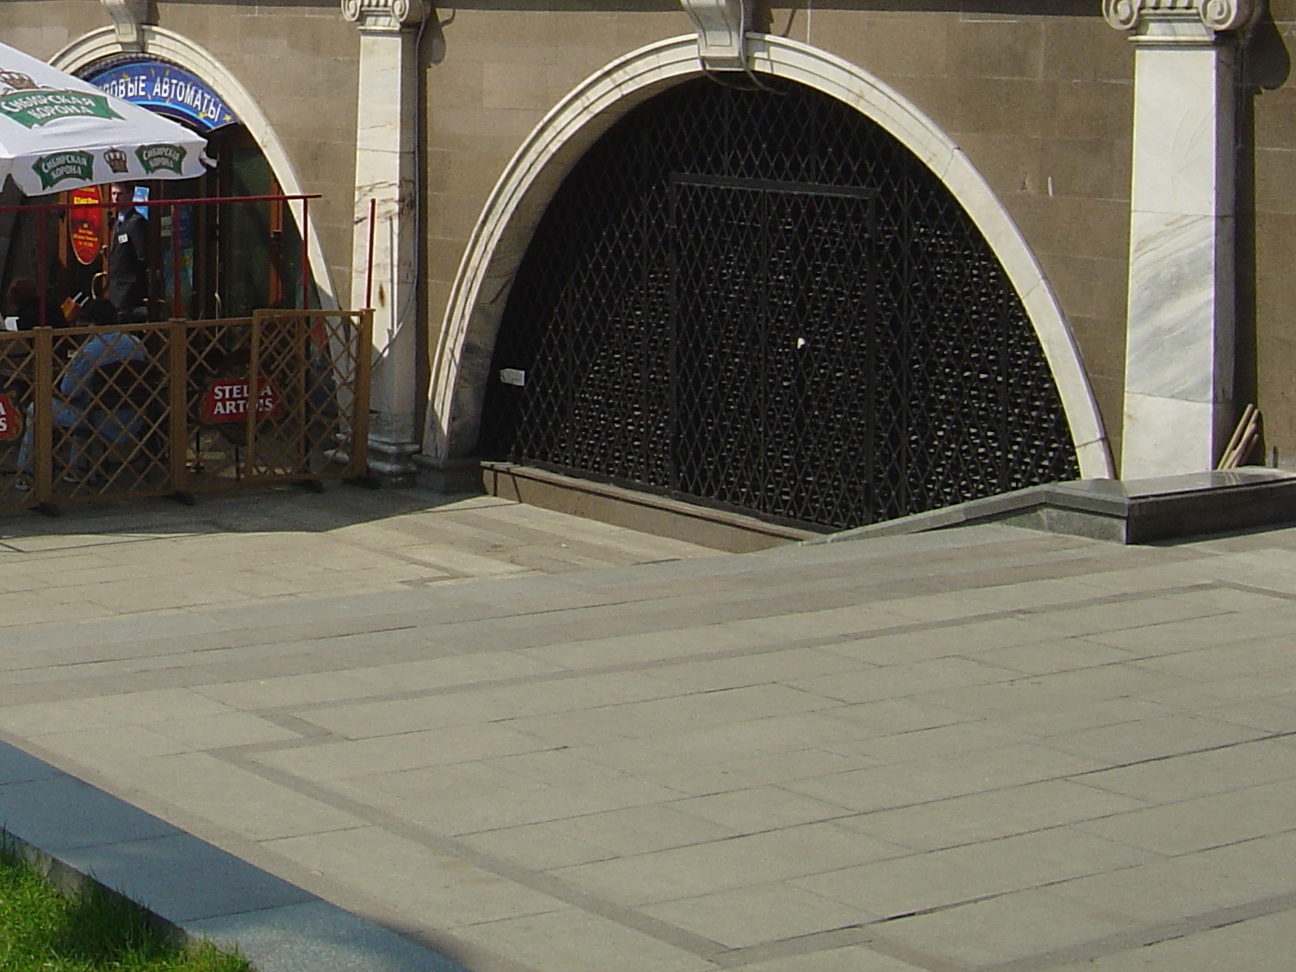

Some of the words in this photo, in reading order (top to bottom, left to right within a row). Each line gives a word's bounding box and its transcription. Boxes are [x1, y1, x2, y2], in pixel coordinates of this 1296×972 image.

[0, 94, 96, 113] СИБИРСКАЯ
[98, 76, 147, 98] РОВЫЕ
[153, 77, 222, 122] АВТОМАТЫ
[27, 105, 94, 119] КОРОНА
[42, 154, 87, 173] СИБИРСКАЯ
[51, 165, 82, 178] КОРОНА
[213, 384, 273, 400] STELA
